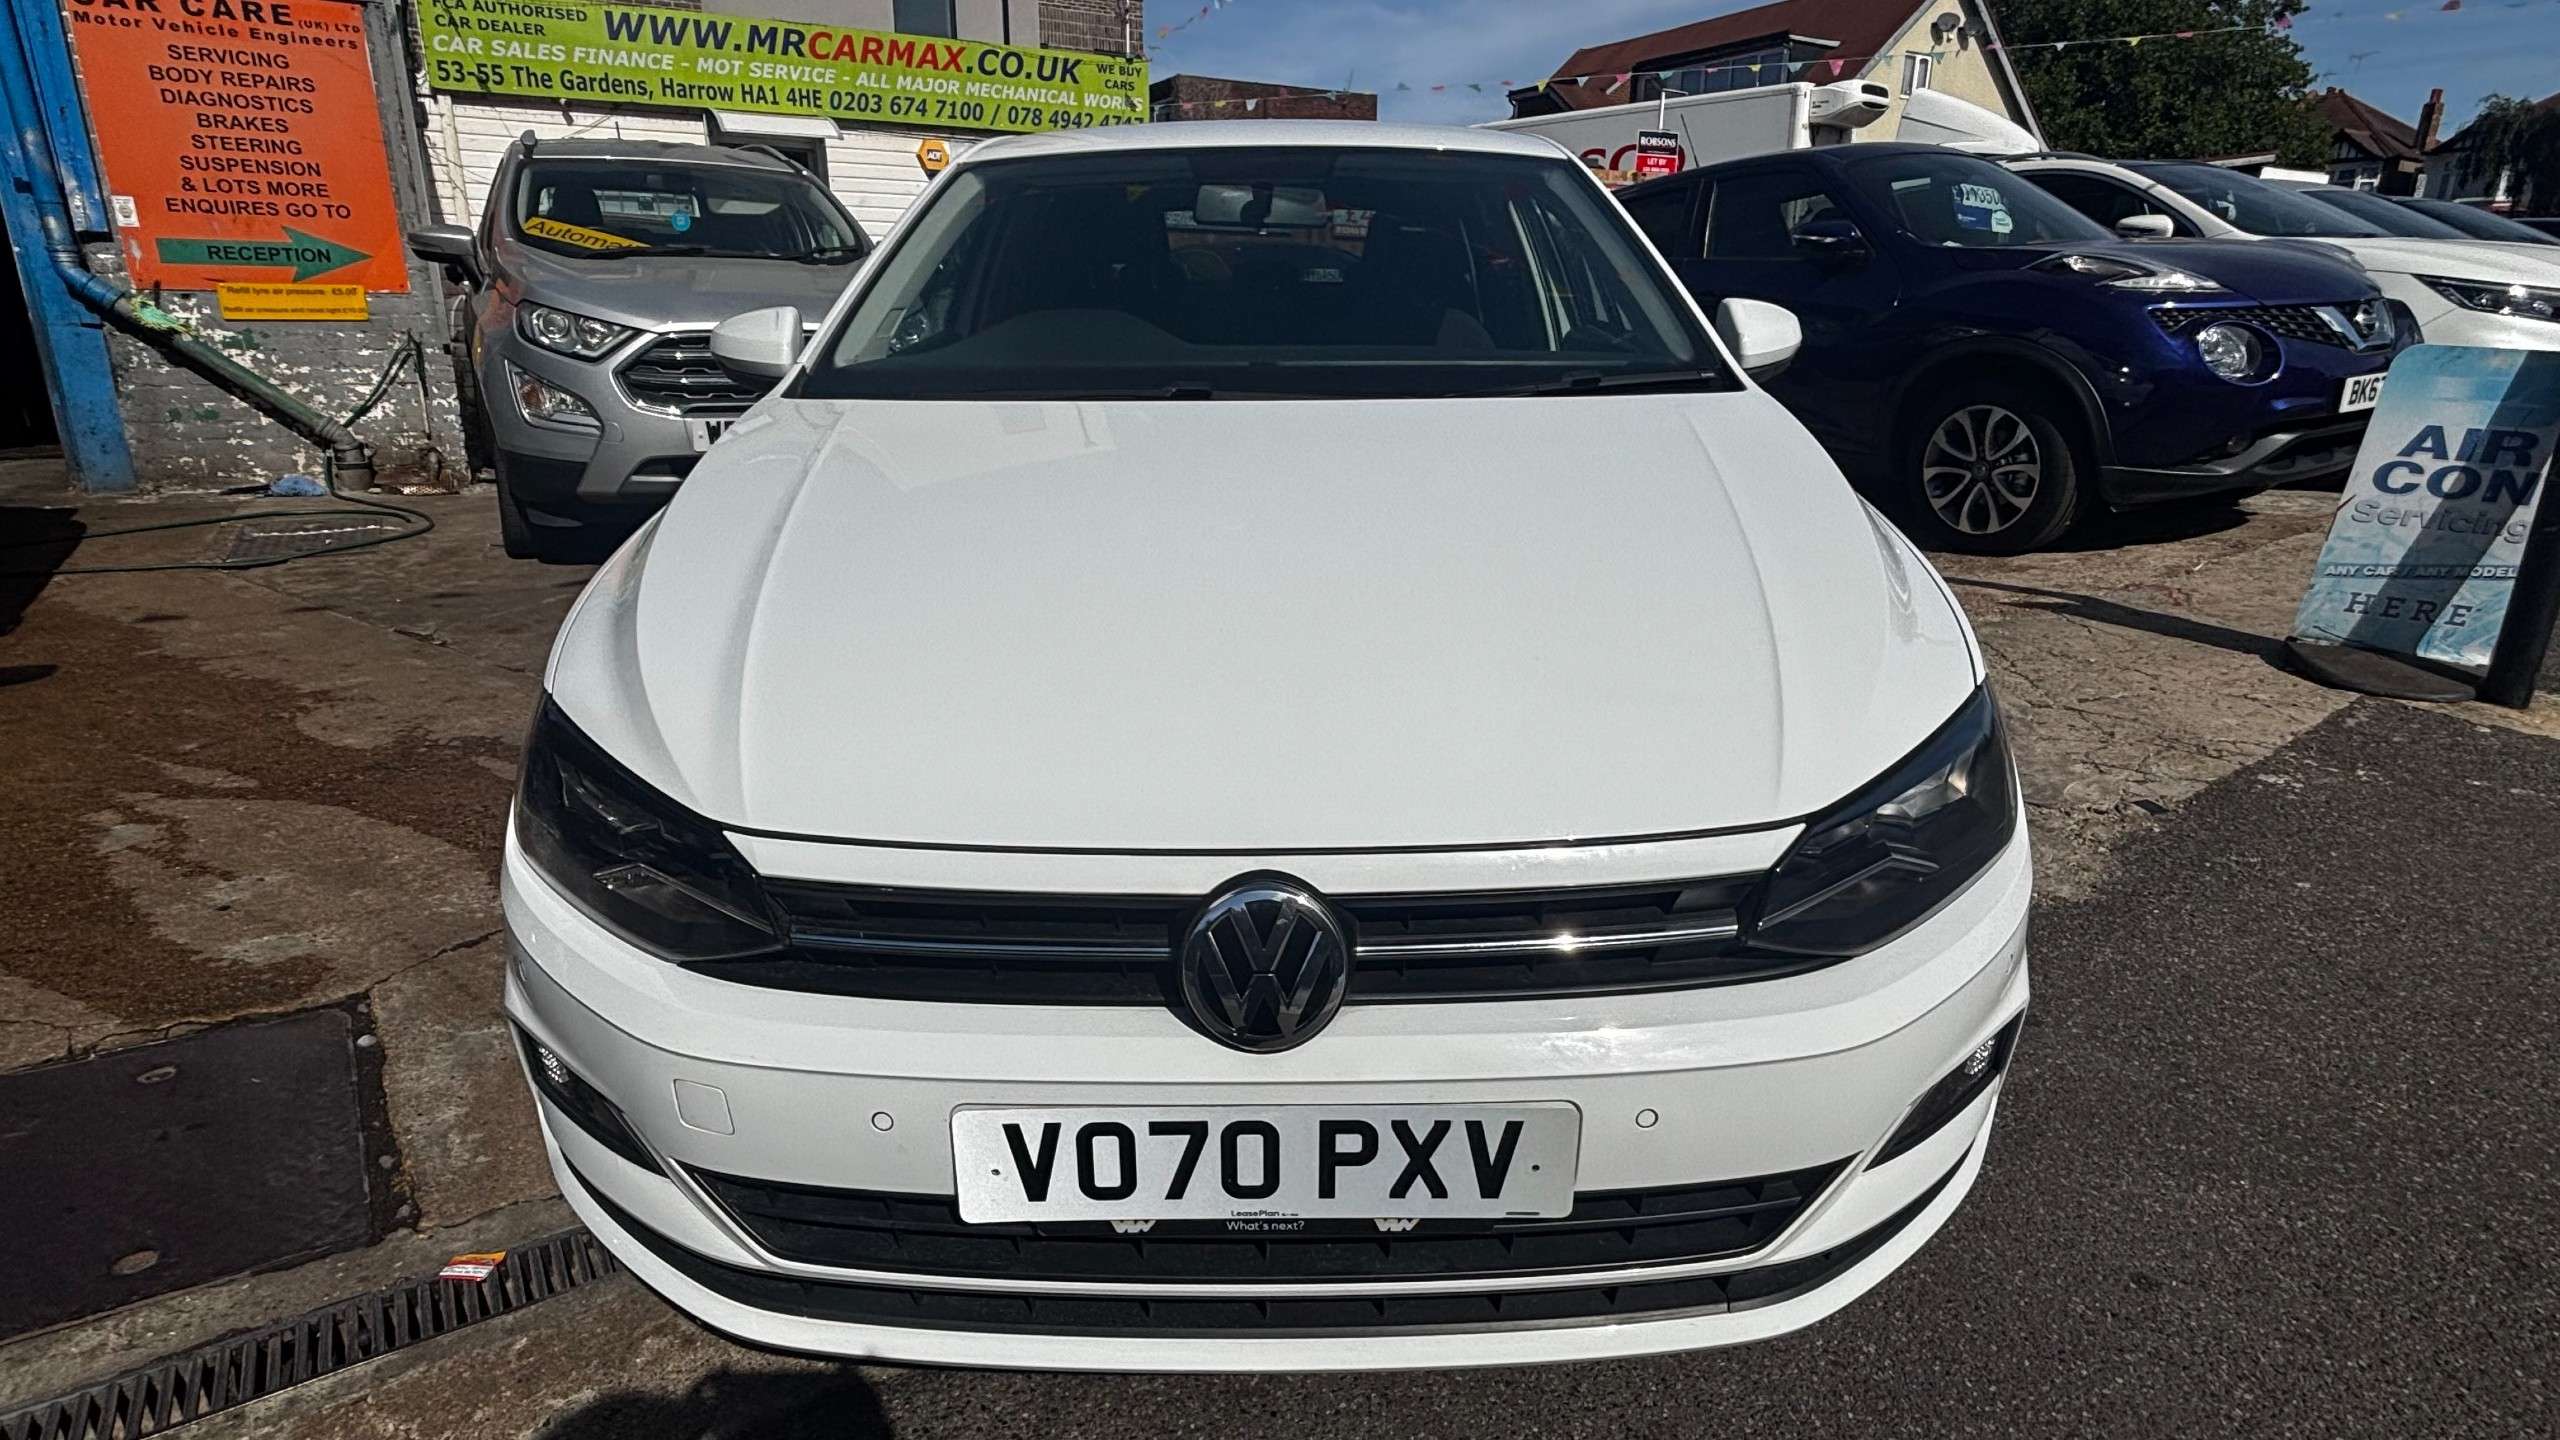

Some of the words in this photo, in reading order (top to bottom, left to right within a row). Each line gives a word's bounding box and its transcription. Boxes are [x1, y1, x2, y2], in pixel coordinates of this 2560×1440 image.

[181, 0, 294, 26] CARE
[335, 23, 360, 33] LTD
[473, 0, 588, 22] AUTHORISED
[73, 10, 142, 28] Motor
[153, 17, 239, 38] Vehicle
[251, 27, 358, 50] Engineers
[434, 14, 472, 30] CAR
[477, 18, 546, 37] DEALER
[168, 44, 289, 69] SERVICING
[604, 10, 1083, 85] WWW.MRCARMAX.CO.UK
[149, 65, 212, 85] BODY
[221, 71, 316, 93] REPAIRS
[433, 35, 483, 55] CAR
[491, 40, 566, 62] SALES
[574, 47, 674, 71] FINANCE
[697, 58, 744, 76] MOT
[750, 62, 836, 84] SERVICE
[856, 72, 891, 89] ALL
[897, 75, 960, 95] MAJOR
[965, 82, 1078, 106] MECHANICAL
[1097, 63, 1115, 75] WE
[1119, 65, 1142, 78] BUY
[436, 60, 505, 86] 53-55
[510, 65, 553, 90] The
[560, 69, 653, 100] Gardens,
[661, 77, 734, 102] Harrow
[741, 84, 779, 105] HA1
[787, 87, 823, 109] 4HE
[829, 90, 882, 114] 0203
[890, 95, 927, 117] 674
[935, 99, 984, 122] 7100
[989, 104, 1001, 126] /
[1008, 105, 1043, 127] 078
[1049, 109, 1093, 129] 4942
[1105, 79, 1135, 92] CARS
[160, 88, 313, 114] DIAGNOSTICS
[197, 113, 289, 133] BRAKES
[191, 134, 302, 155] STEERING
[180, 155, 321, 177] SUSPENSION
[181, 177, 197, 192] &
[204, 178, 261, 195] LOTS
[267, 181, 329, 198] MORE
[165, 198, 279, 217] ENQUIRES
[286, 203, 317, 218] GO
[323, 204, 351, 219] TO
[207, 245, 332, 263] RECEPTION
[2347, 376, 2387, 405] BK6
[2396, 424, 2541, 468] AIR
[2373, 460, 2542, 507] CON
[2351, 500, 2530, 545] Servicing
[2324, 565, 2360, 576] ANY
[2363, 566, 2399, 577] CAR
[2413, 567, 2449, 577] ANY
[2452, 567, 2518, 578] MODEL
[2343, 592, 2473, 628] HERE
[1002, 1121, 1281, 1202] VO70
[1318, 1120, 1525, 1200] PXV
[1226, 1220, 1269, 1231] What's
[1271, 1220, 1305, 1231] next?
